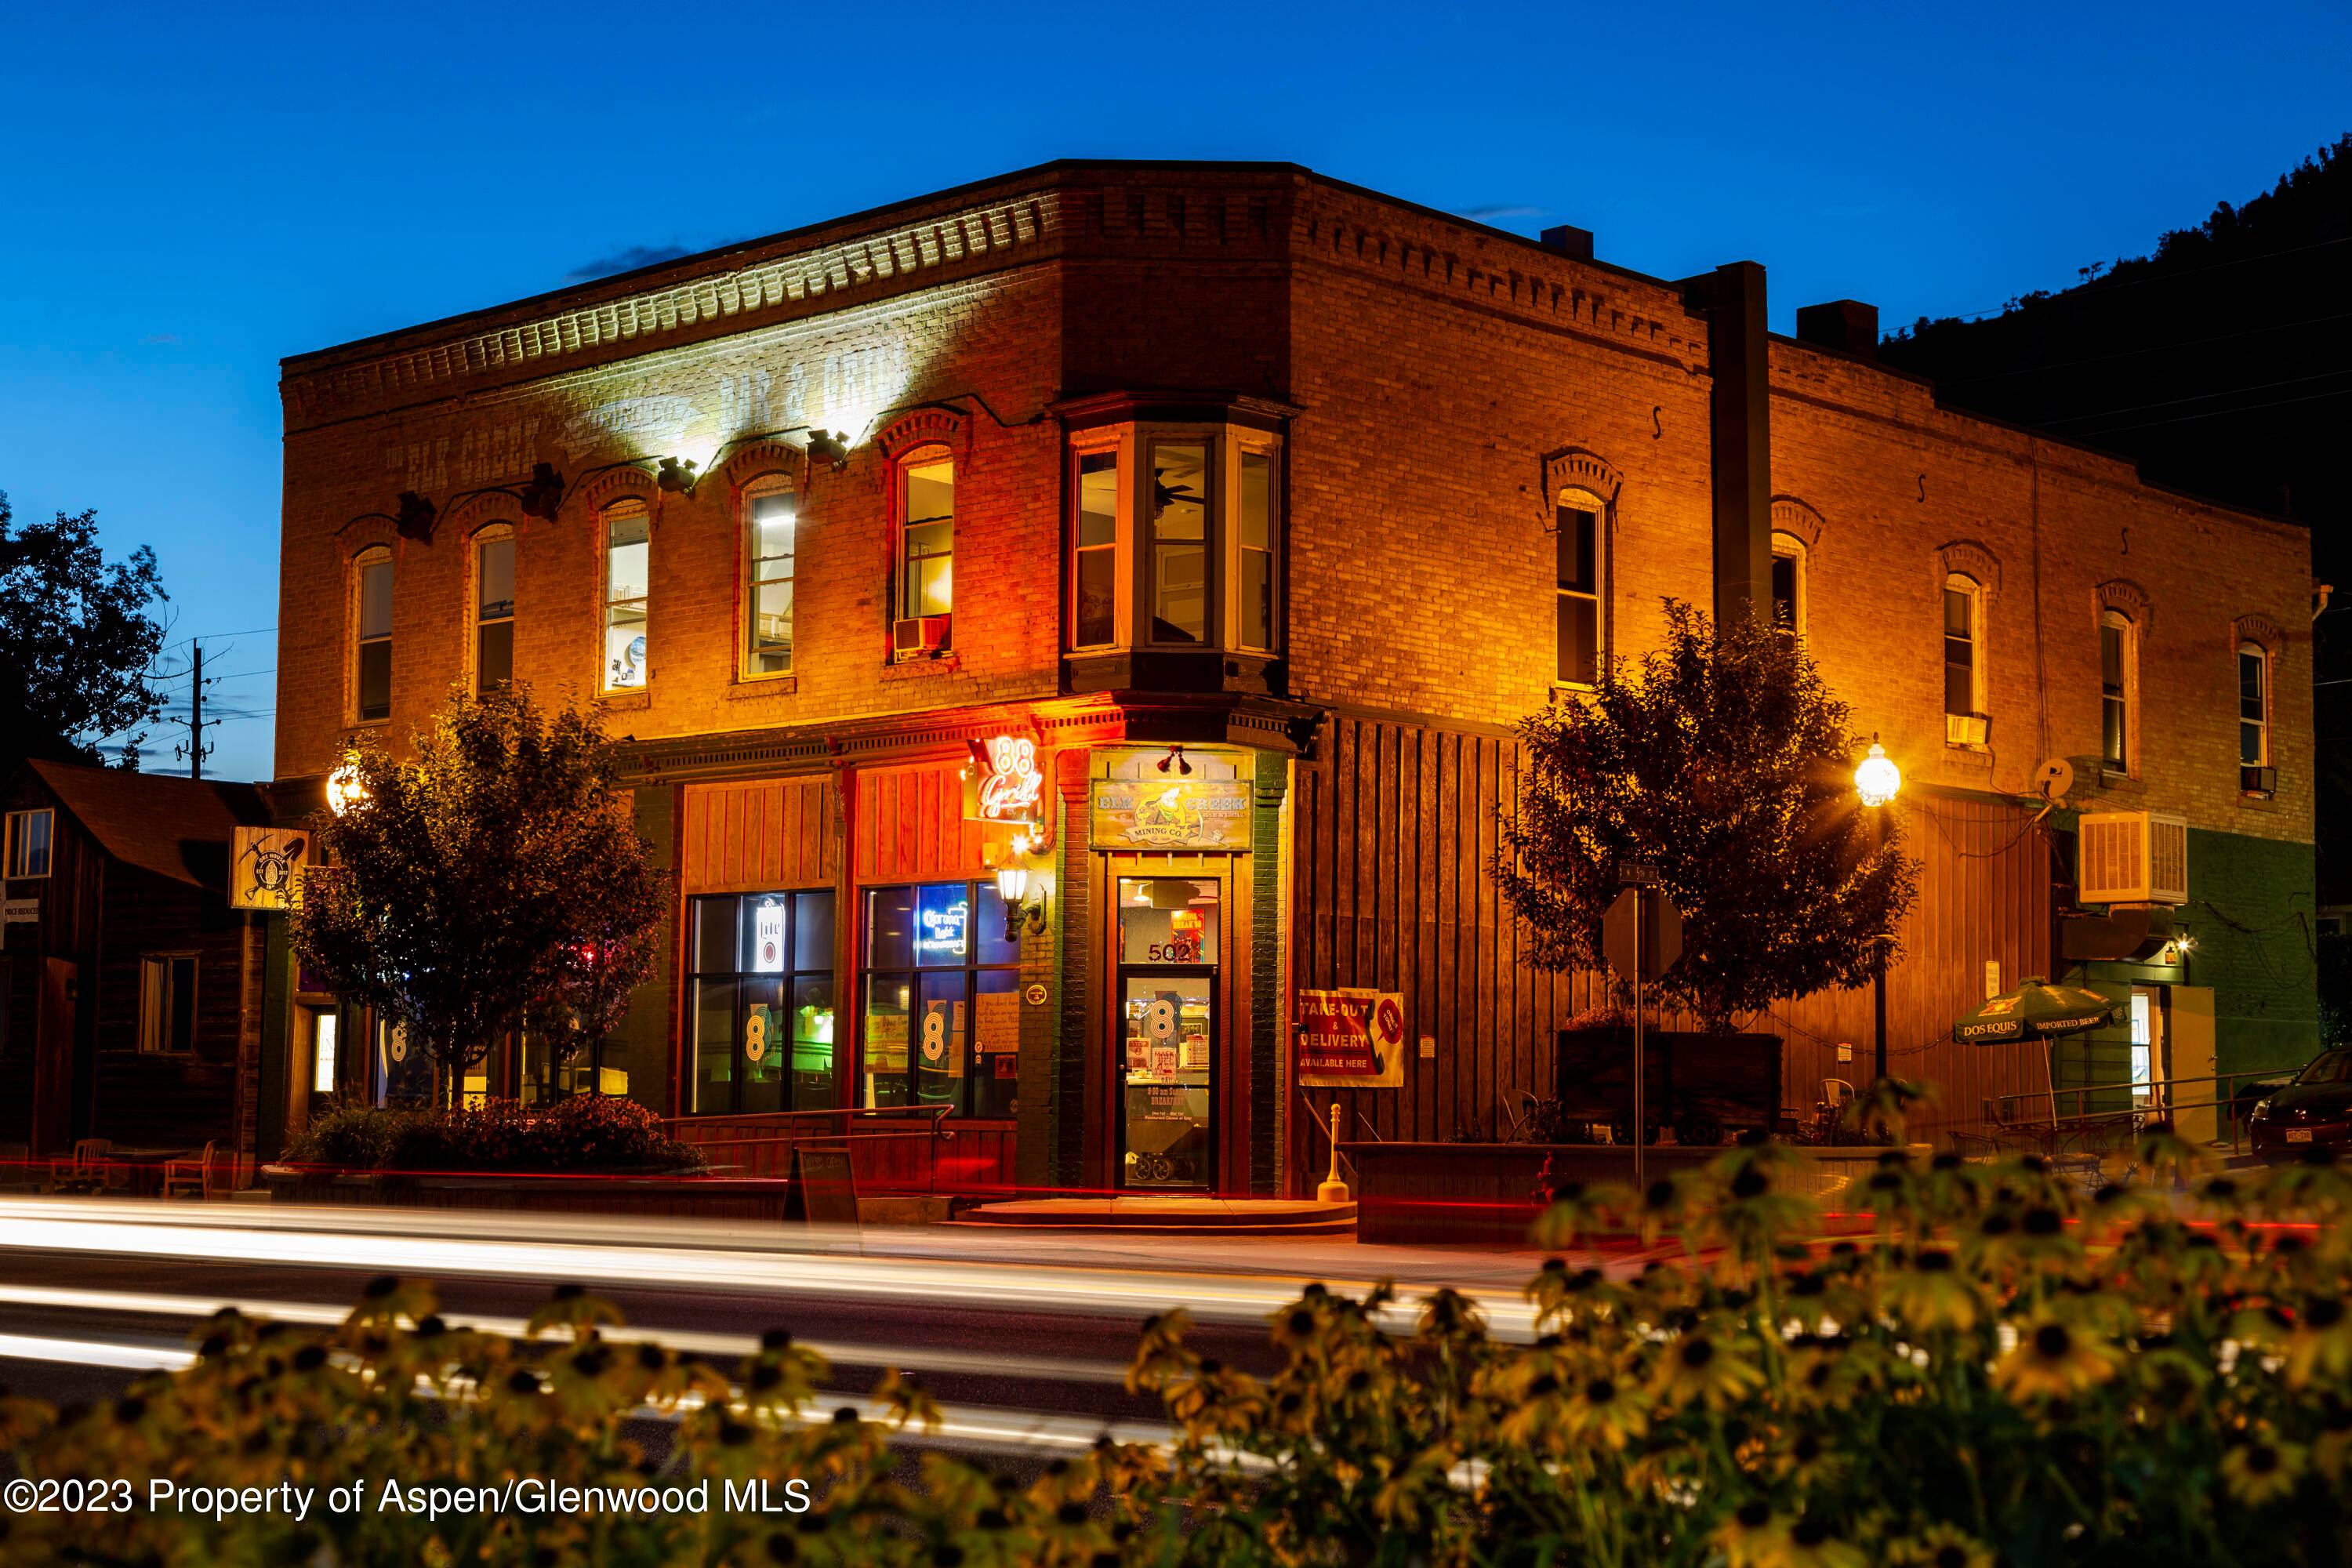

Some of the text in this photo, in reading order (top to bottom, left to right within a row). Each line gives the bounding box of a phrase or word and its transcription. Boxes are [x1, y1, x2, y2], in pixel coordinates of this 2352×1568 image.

[996, 736, 1034, 779] 88
[985, 771, 1042, 818] Grill
[1098, 797, 1247, 811] ELK CREEK
[1134, 828, 1167, 837] MINING
[260, 853, 286, 864] ORE HOUSE
[924, 910, 960, 927] Corona
[1148, 944, 1190, 962] 502
[1301, 1002, 1368, 1017] TAKE-OUT
[1333, 1022, 1338, 1030] &
[1964, 1021, 2017, 1036] DOS EQUIS
[2036, 1017, 2100, 1030] IMPORTED BEER
[1301, 1034, 1367, 1047] DELIVERY
[1300, 1058, 1367, 1068] AVAILABLE HERE
